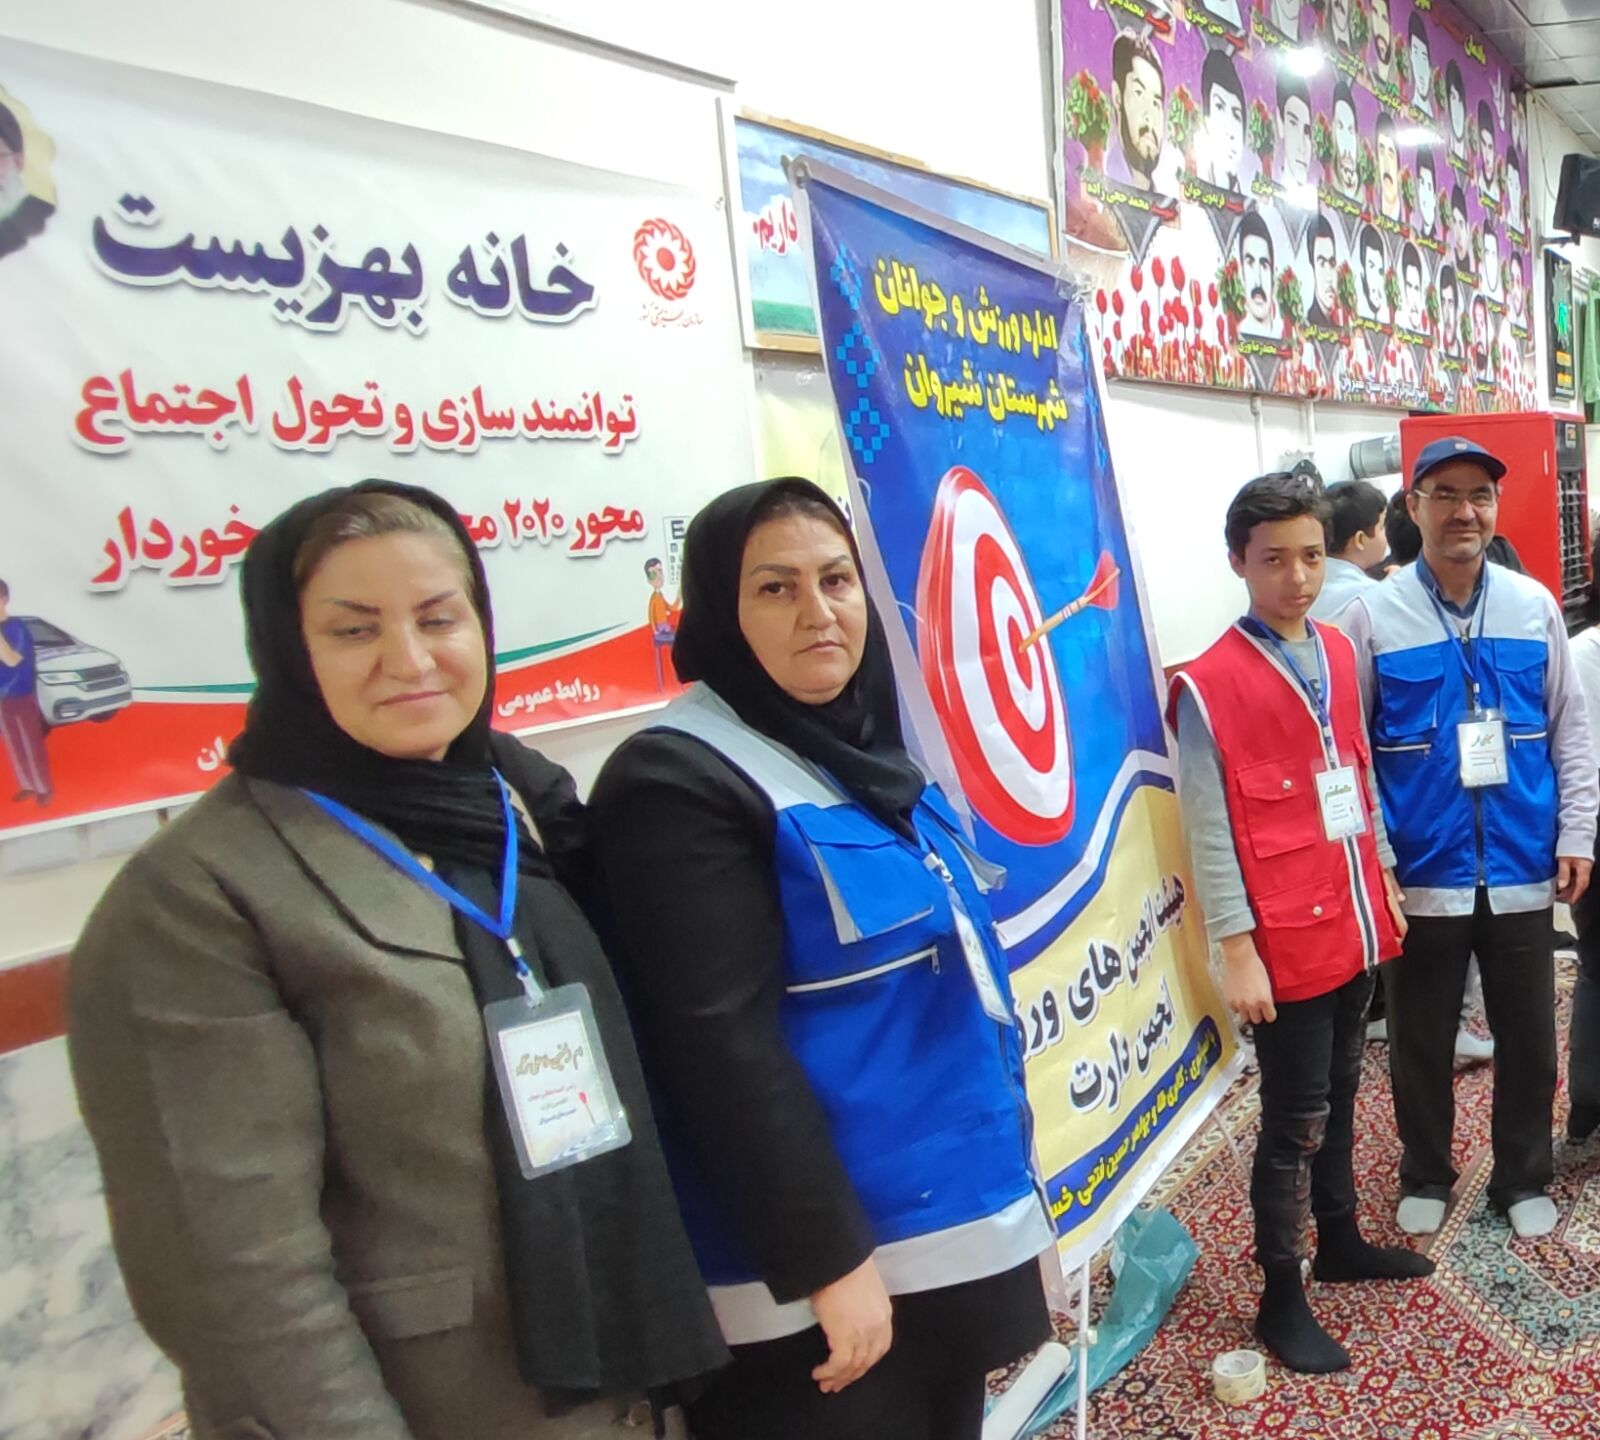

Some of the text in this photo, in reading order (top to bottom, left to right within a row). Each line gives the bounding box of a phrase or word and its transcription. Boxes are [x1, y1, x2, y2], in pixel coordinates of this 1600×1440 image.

[92, 192, 596, 334] خانه بهزیست
[874, 258, 1058, 358] اداره ورزش و جوانان
[75, 369, 637, 448] توانمند سازی و تحول اجتماع
[903, 351, 1068, 431] شهرستان شیروان
[90, 507, 260, 584] خوردار
[502, 497, 564, 540] ۲۰۲۰
[569, 505, 645, 551] محور
[497, 677, 601, 717] روابط عمومی
[1127, 895, 1156, 985] انجمن
[1068, 942, 1121, 1021] های
[1014, 989, 1060, 1056] ورز
[1136, 974, 1176, 1073] انجمن
[1068, 1031, 1129, 1111] دارت
